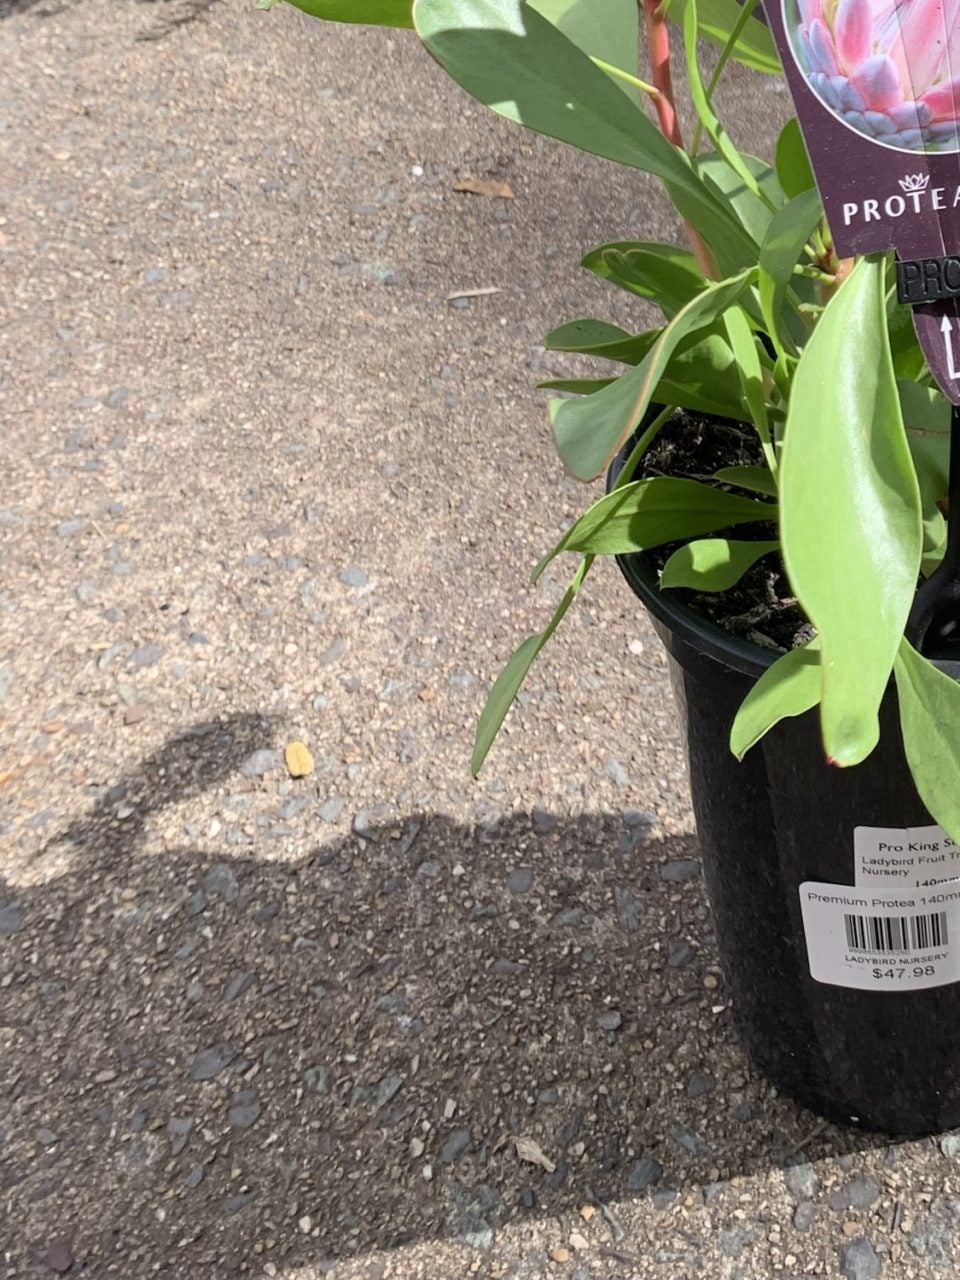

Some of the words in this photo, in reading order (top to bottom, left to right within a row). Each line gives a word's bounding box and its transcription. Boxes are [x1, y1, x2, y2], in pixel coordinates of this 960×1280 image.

[878, 842, 904, 853] Pro
[908, 841, 940, 853] King
[861, 855, 914, 867] Ladybird
[918, 854, 945, 864] Fruit
[861, 866, 910, 878] Nursery
[807, 892, 868, 908] Premium
[871, 898, 916, 909] Protea
[844, 954, 897, 966] LADYBIRD
[898, 952, 949, 966] NURSERY
[872, 965, 936, 980] $47.98
